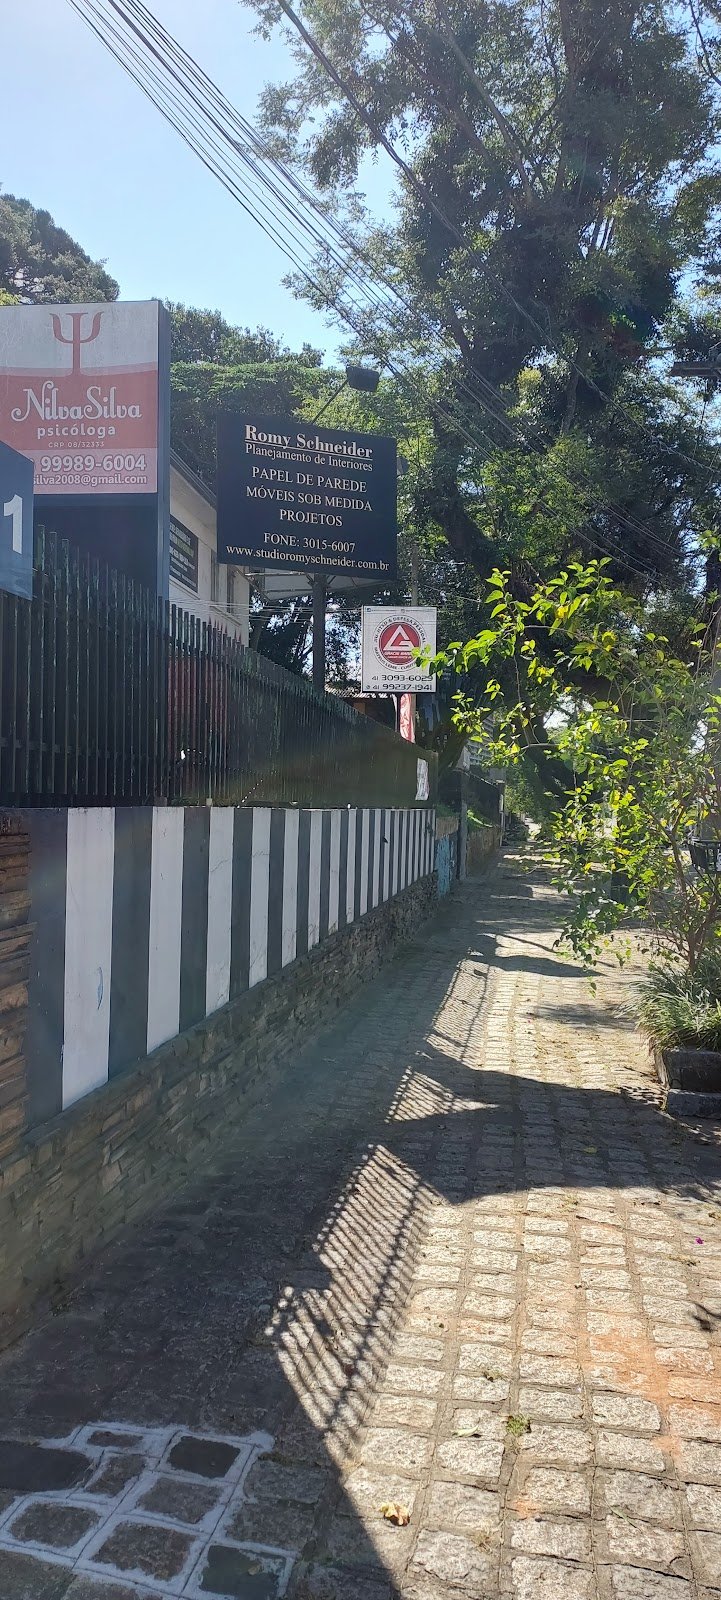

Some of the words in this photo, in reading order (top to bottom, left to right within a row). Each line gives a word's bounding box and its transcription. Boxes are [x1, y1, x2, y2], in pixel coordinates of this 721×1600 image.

[37, 424, 116, 439] psicóloga
[244, 424, 291, 449] Romy
[296, 433, 374, 458] Schneider
[40, 453, 147, 473] 99989-6004
[245, 443, 312, 463] Planejamento
[314, 453, 326, 465] de
[328, 456, 373, 472] Interiores
[251, 466, 294, 483] PAPEL
[296, 472, 314, 486] DE
[317, 475, 367, 493] PAREDE
[246, 484, 295, 502] MÓVEIS
[297, 492, 322, 505] SOB
[324, 495, 373, 511] MEDIDA
[279, 508, 343, 527] PROJETOS
[263, 532, 300, 547] FONE:
[302, 537, 356, 553] 3015-6007
[226, 544, 389, 571] www.studioromyschneider.com.br
